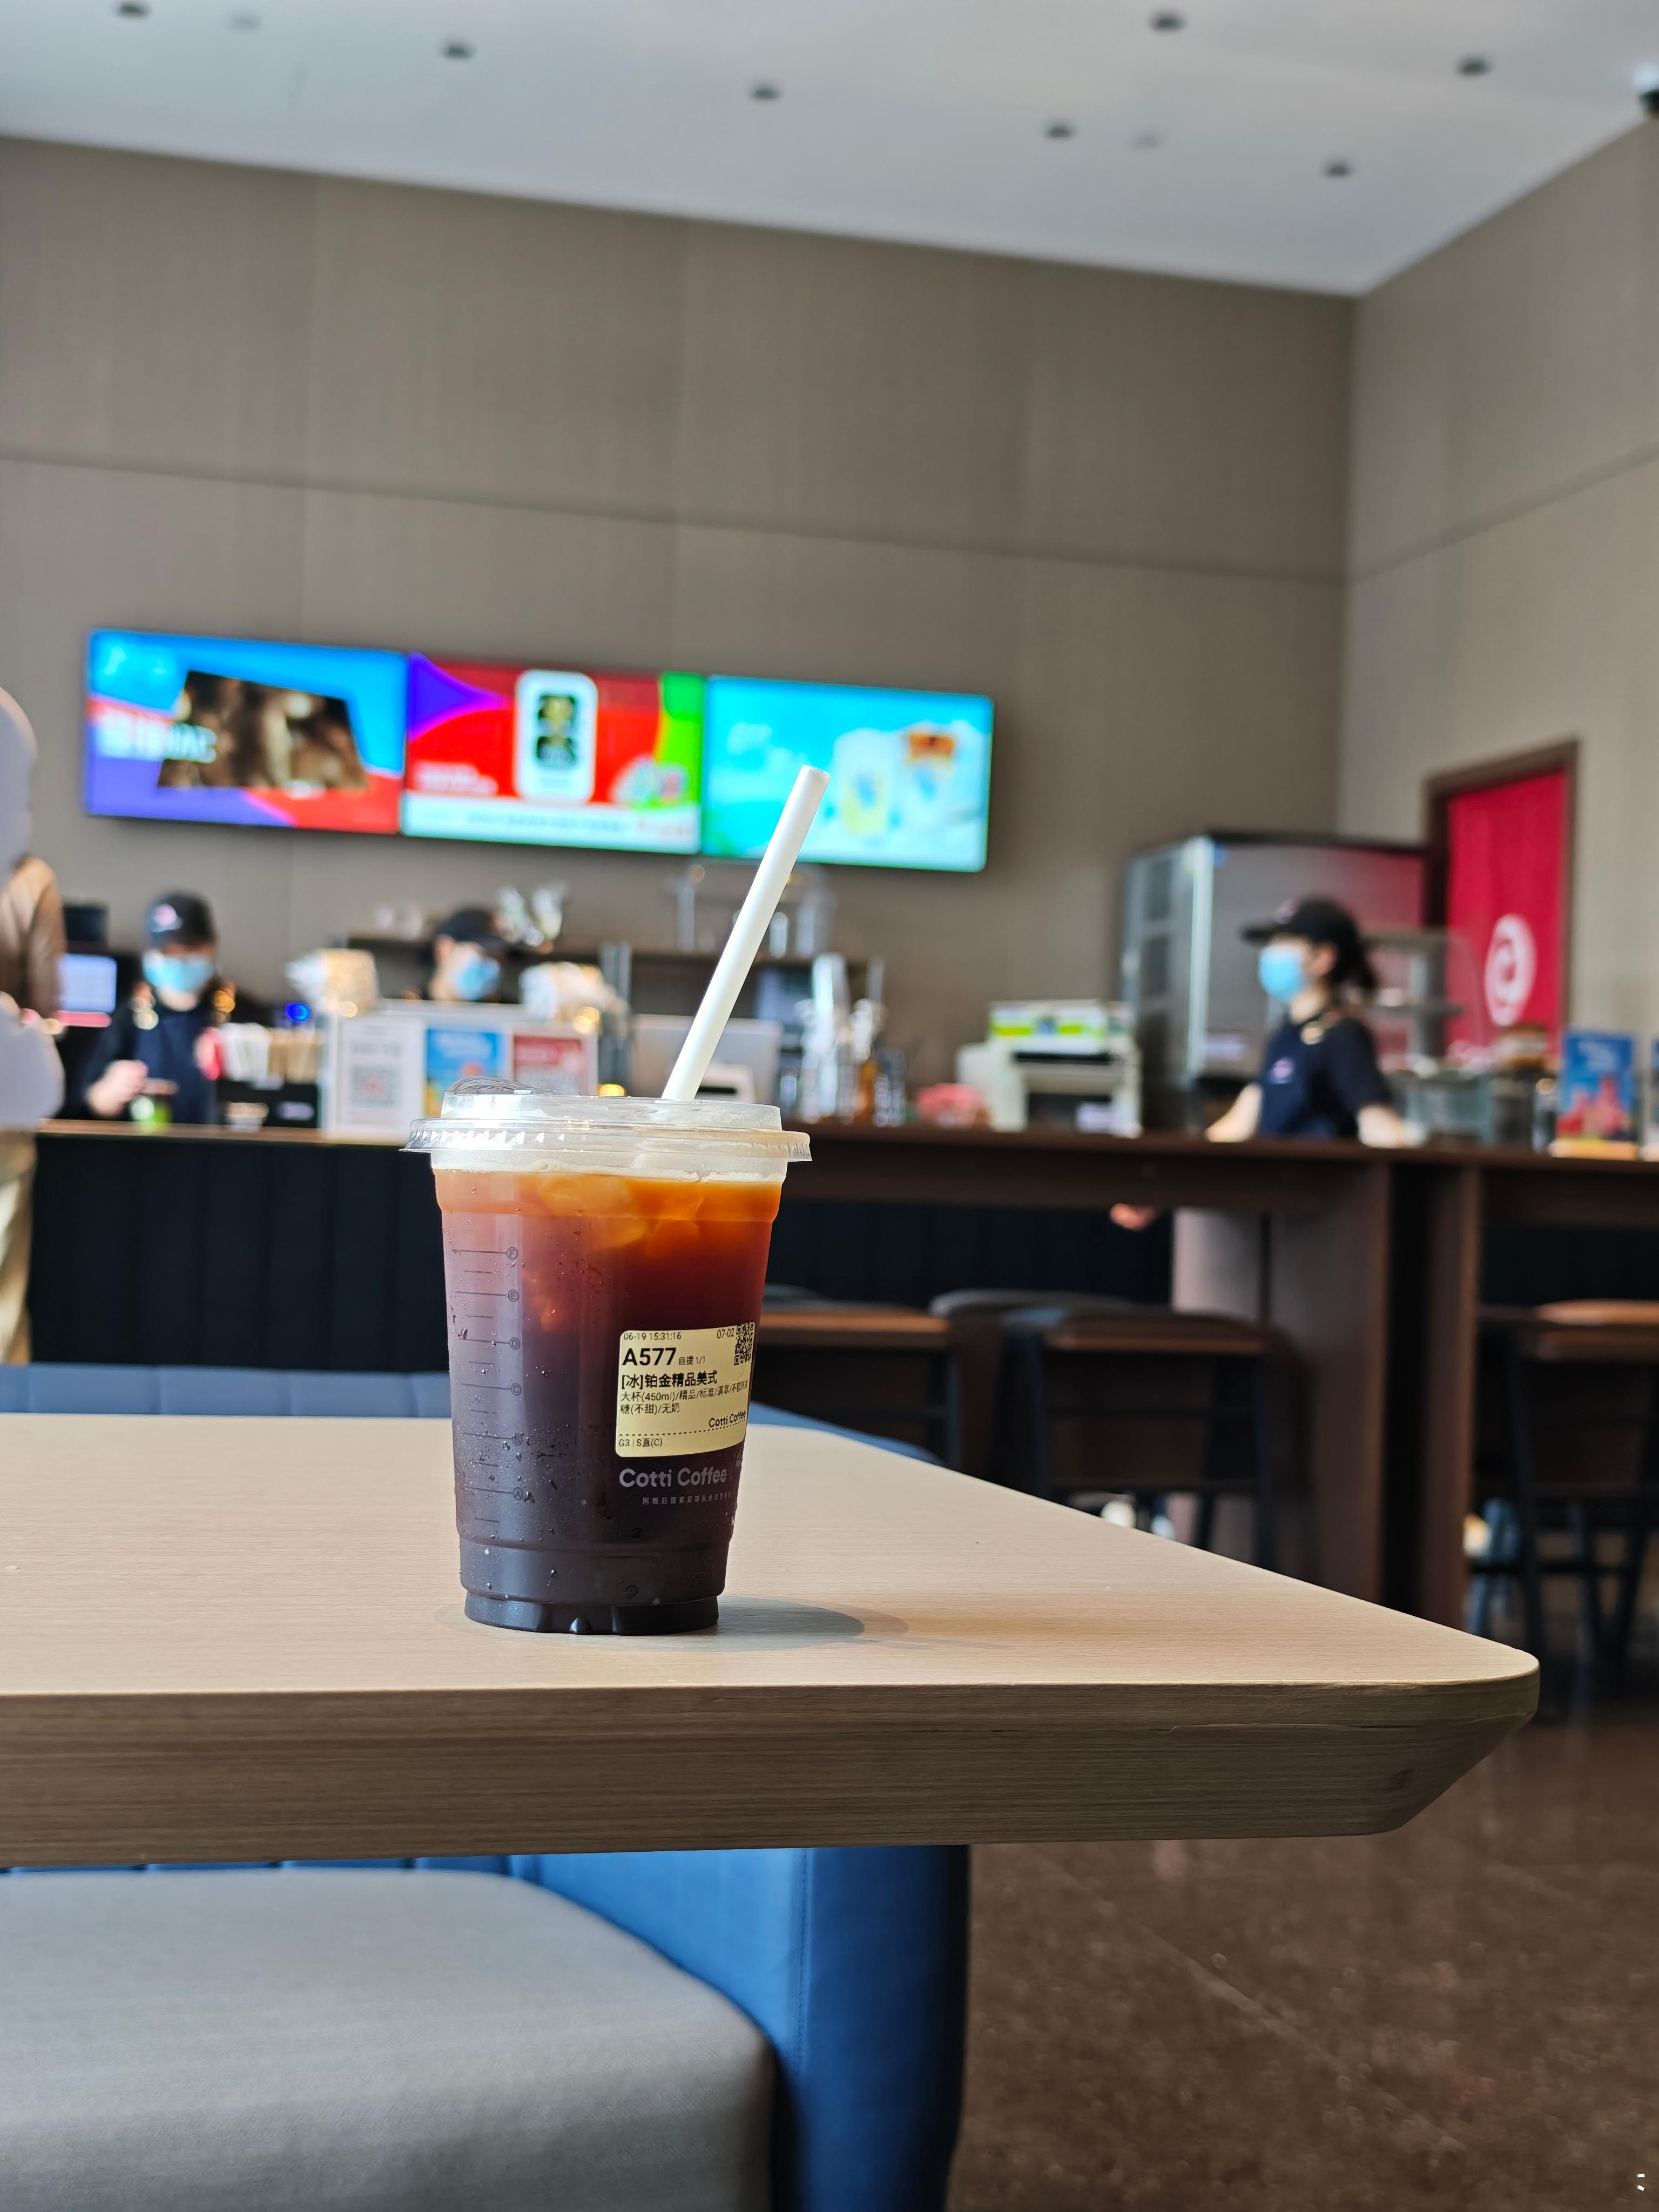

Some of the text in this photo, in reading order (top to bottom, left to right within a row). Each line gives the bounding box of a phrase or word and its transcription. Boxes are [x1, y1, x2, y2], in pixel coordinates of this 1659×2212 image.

[623, 1332, 682, 1340] 06-19 15:31:16
[717, 1327, 734, 1339] 07-02
[622, 1347, 677, 1366] A577
[696, 1355, 705, 1365] 1/1
[622, 1370, 718, 1390] [冰]铂金精品美式
[709, 1410, 746, 1428] Cotti Coffee
[618, 1438, 630, 1447] G3
[619, 1466, 727, 1488] Cotti Coffee
